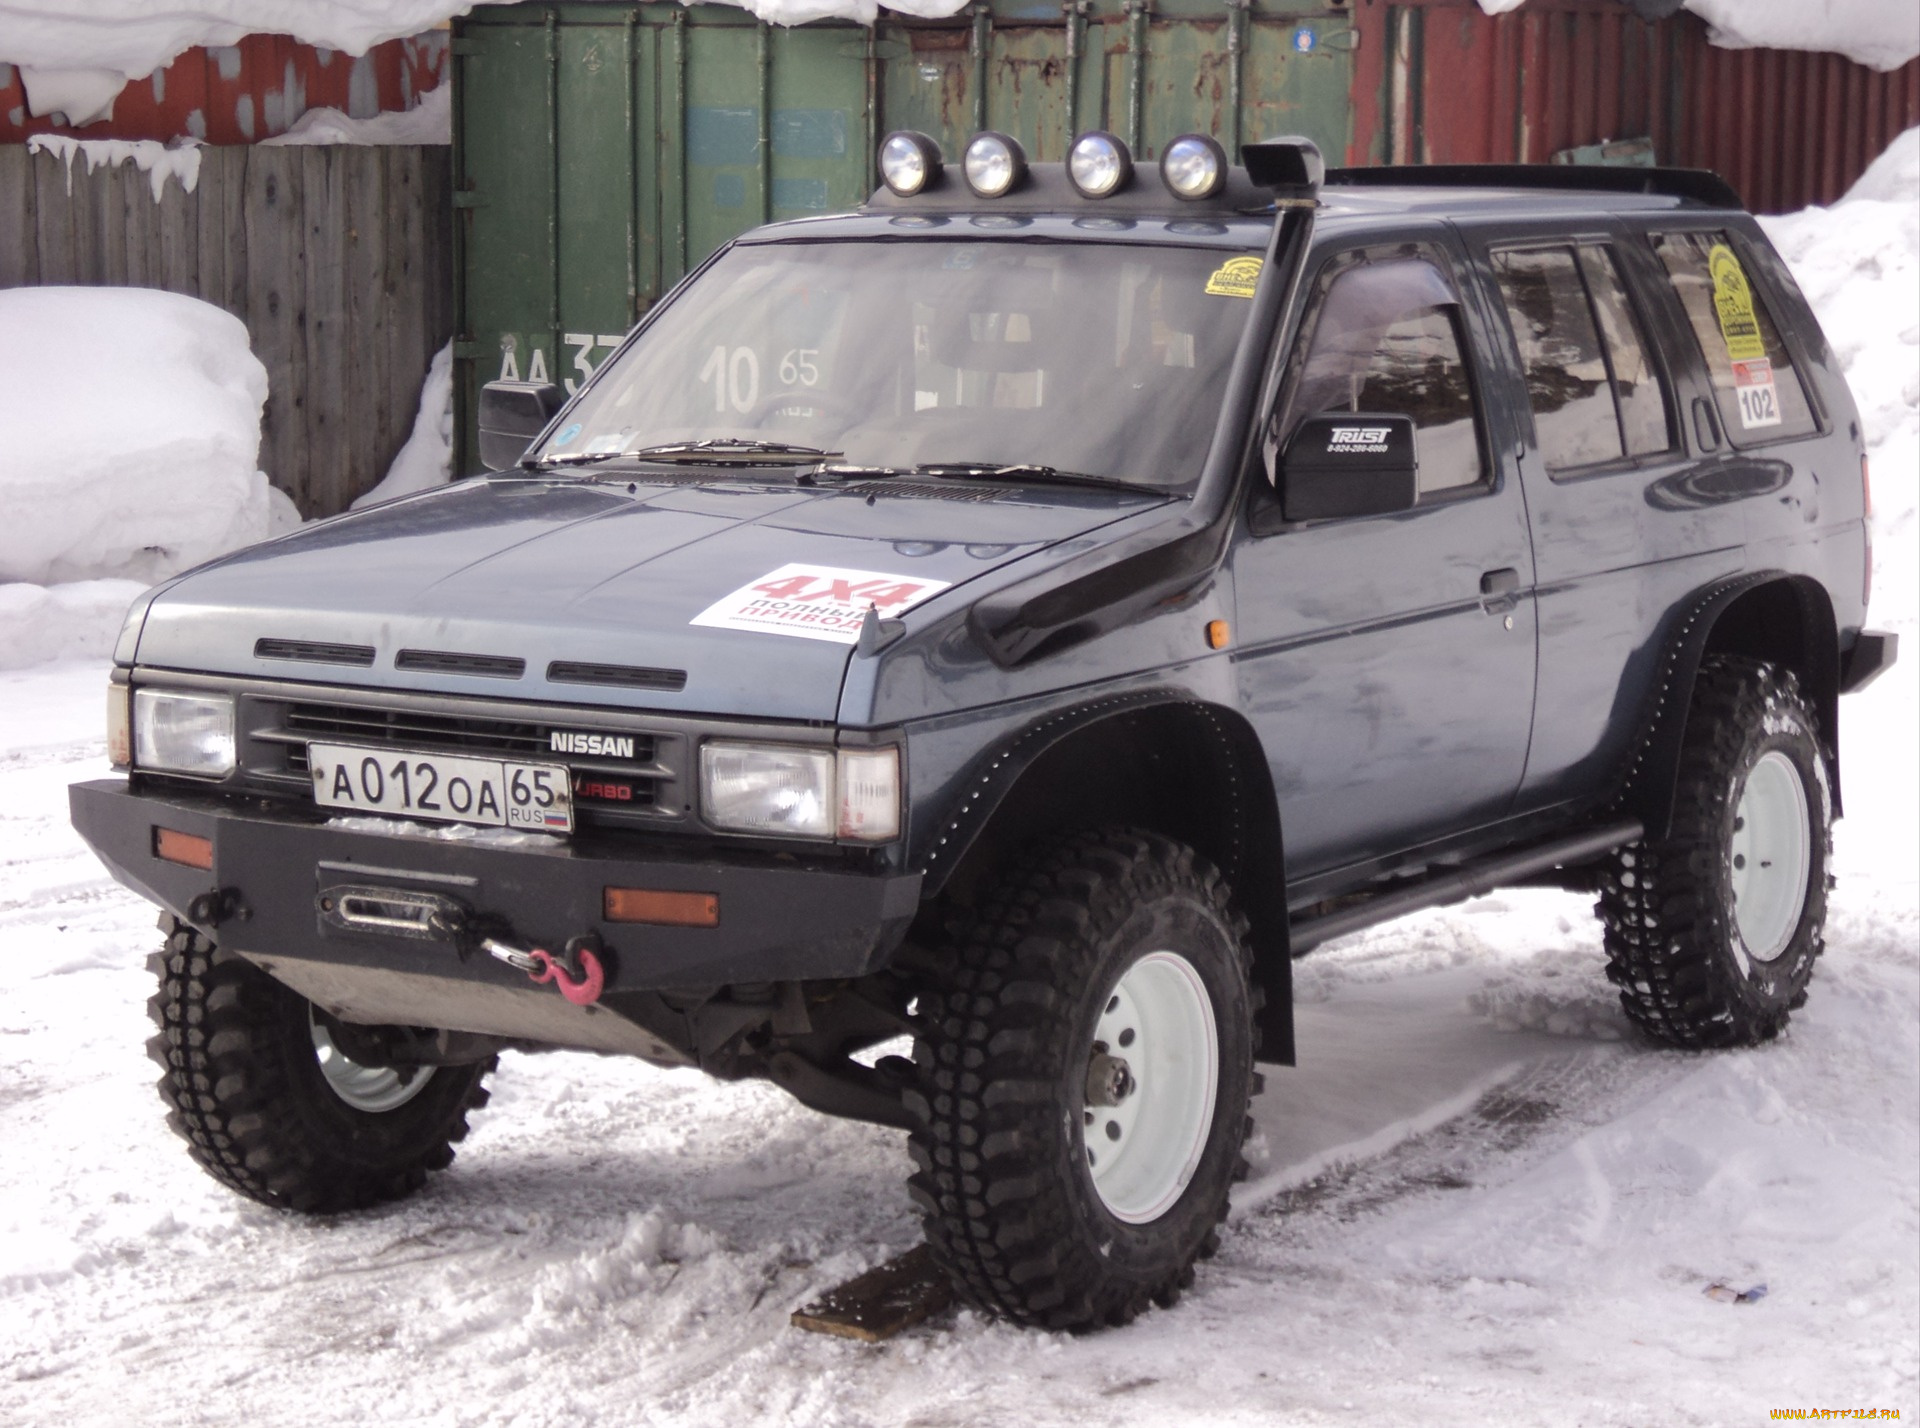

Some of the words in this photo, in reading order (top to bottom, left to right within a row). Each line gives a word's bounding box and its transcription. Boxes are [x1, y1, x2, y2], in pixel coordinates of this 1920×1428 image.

[700, 345, 760, 414] 10
[779, 349, 819, 386] 65
[1742, 389, 1774, 421] 102
[1331, 427, 1392, 443] TRUST
[550, 731, 634, 758] NISSAN
[510, 768, 555, 808] 65
[574, 782, 632, 800] URBO
[510, 807, 543, 824] RUS
